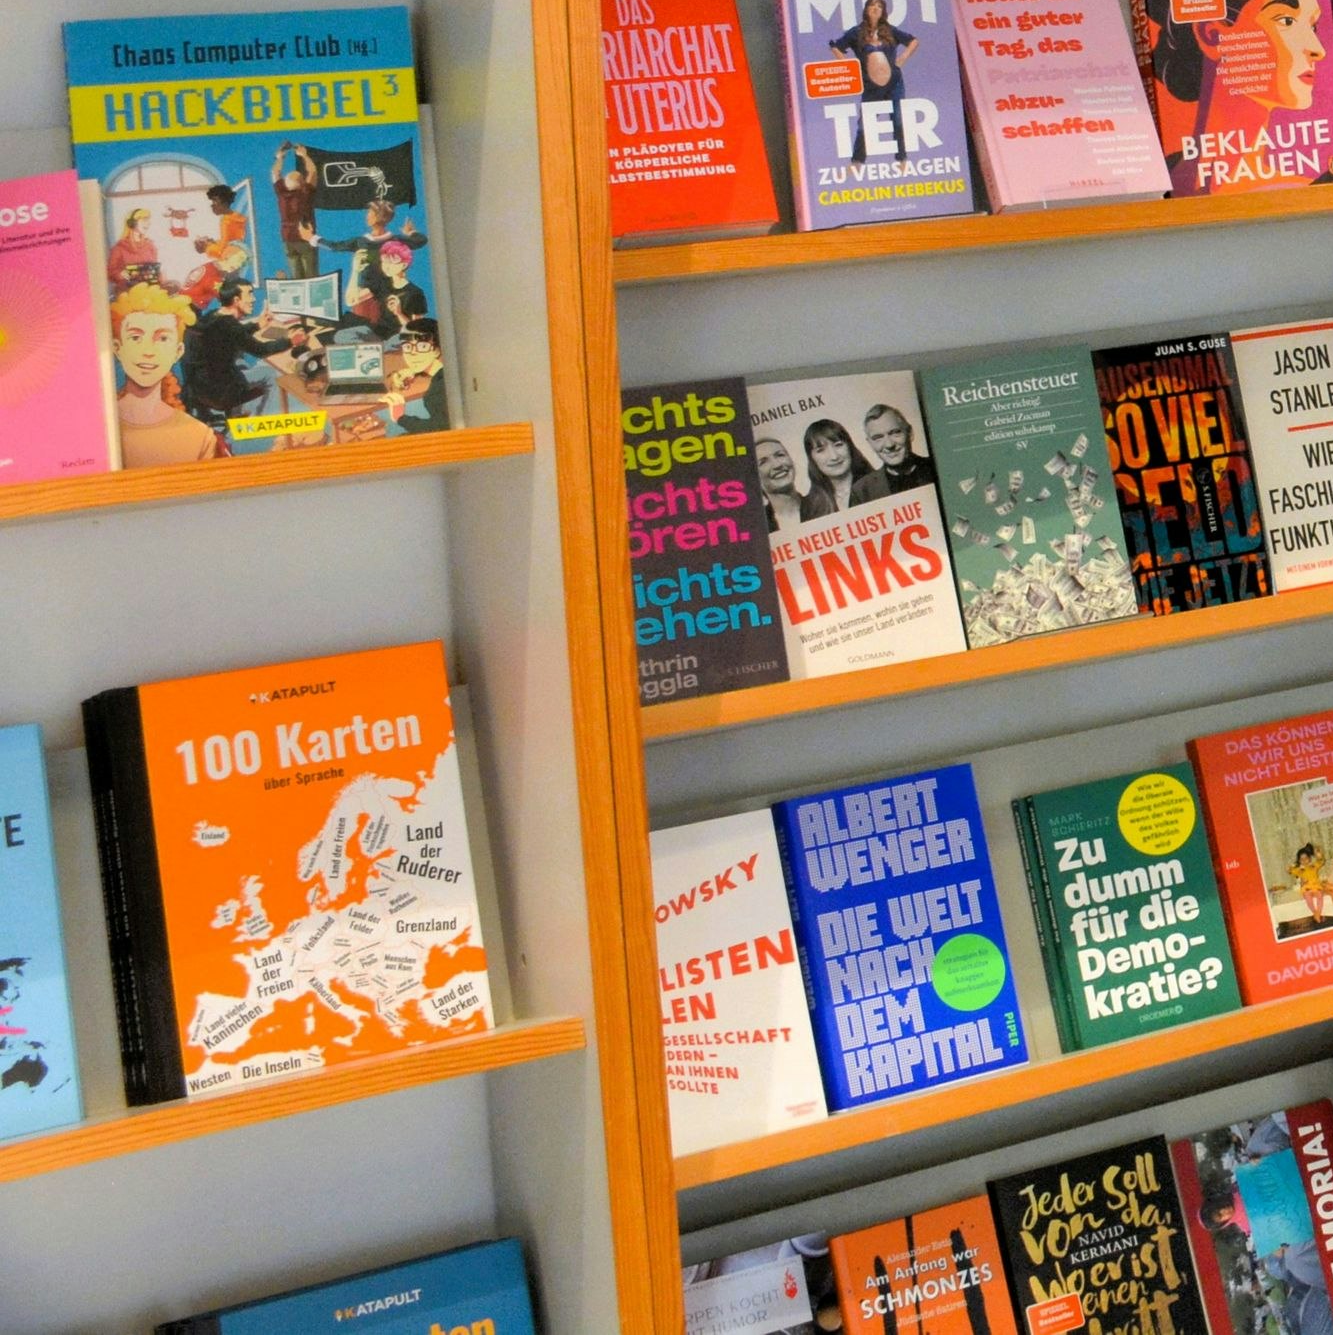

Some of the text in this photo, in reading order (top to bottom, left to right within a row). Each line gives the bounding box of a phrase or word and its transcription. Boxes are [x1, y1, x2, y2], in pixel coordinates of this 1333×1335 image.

[973, 11, 1084, 32] ein guter
[113, 42, 175, 68] Chaos
[183, 38, 288, 65] Computer
[295, 34, 341, 59] Club
[978, 37, 1083, 60] Tag, das
[613, 79, 725, 136] UTERUS
[995, 94, 1065, 110] abzu-
[824, 98, 943, 158] TER
[1002, 117, 1115, 139] schaffen
[1182, 119, 1331, 161] BEKLAUTE
[1197, 148, 1321, 188] FRAUEN
[818, 179, 965, 206] CAROLIN KEBEKUS
[1273, 343, 1331, 376] JASON
[942, 370, 1079, 407] Reichensteuer
[237, 414, 320, 435] KATAPULT
[752, 394, 825, 427] DANIEL BAX
[984, 414, 1014, 428] Gabriel
[798, 501, 923, 554] NEUE LUST AUF
[775, 524, 943, 626] LINKS
[258, 681, 336, 704] KATAPULT
[175, 714, 422, 787] 100 Karten
[797, 778, 938, 849] ALBERT
[806, 818, 976, 893] WENGER
[1054, 837, 1107, 872] Zu
[1064, 859, 1185, 909] dumm
[302, 916, 336, 953] Volksland
[396, 916, 457, 934] Grenzland
[817, 880, 983, 958] DIE WELT
[1070, 891, 1200, 947] für die
[825, 936, 936, 1005] NACH
[1077, 933, 1206, 981] Demo-
[1083, 956, 1223, 1020] kratie?
[203, 1003, 263, 1051] Kaninchen
[835, 988, 925, 1051] DEM
[1003, 1012, 1019, 1047] PIPER
[842, 1018, 1003, 1098] KAPITAL
[189, 1069, 232, 1093] Westen
[1069, 1235, 1140, 1265] KERMANI
[1077, 1224, 1126, 1247] NAVID
[334, 1289, 422, 1321] KATAPULT
[860, 1264, 993, 1320] SCHMONZES
